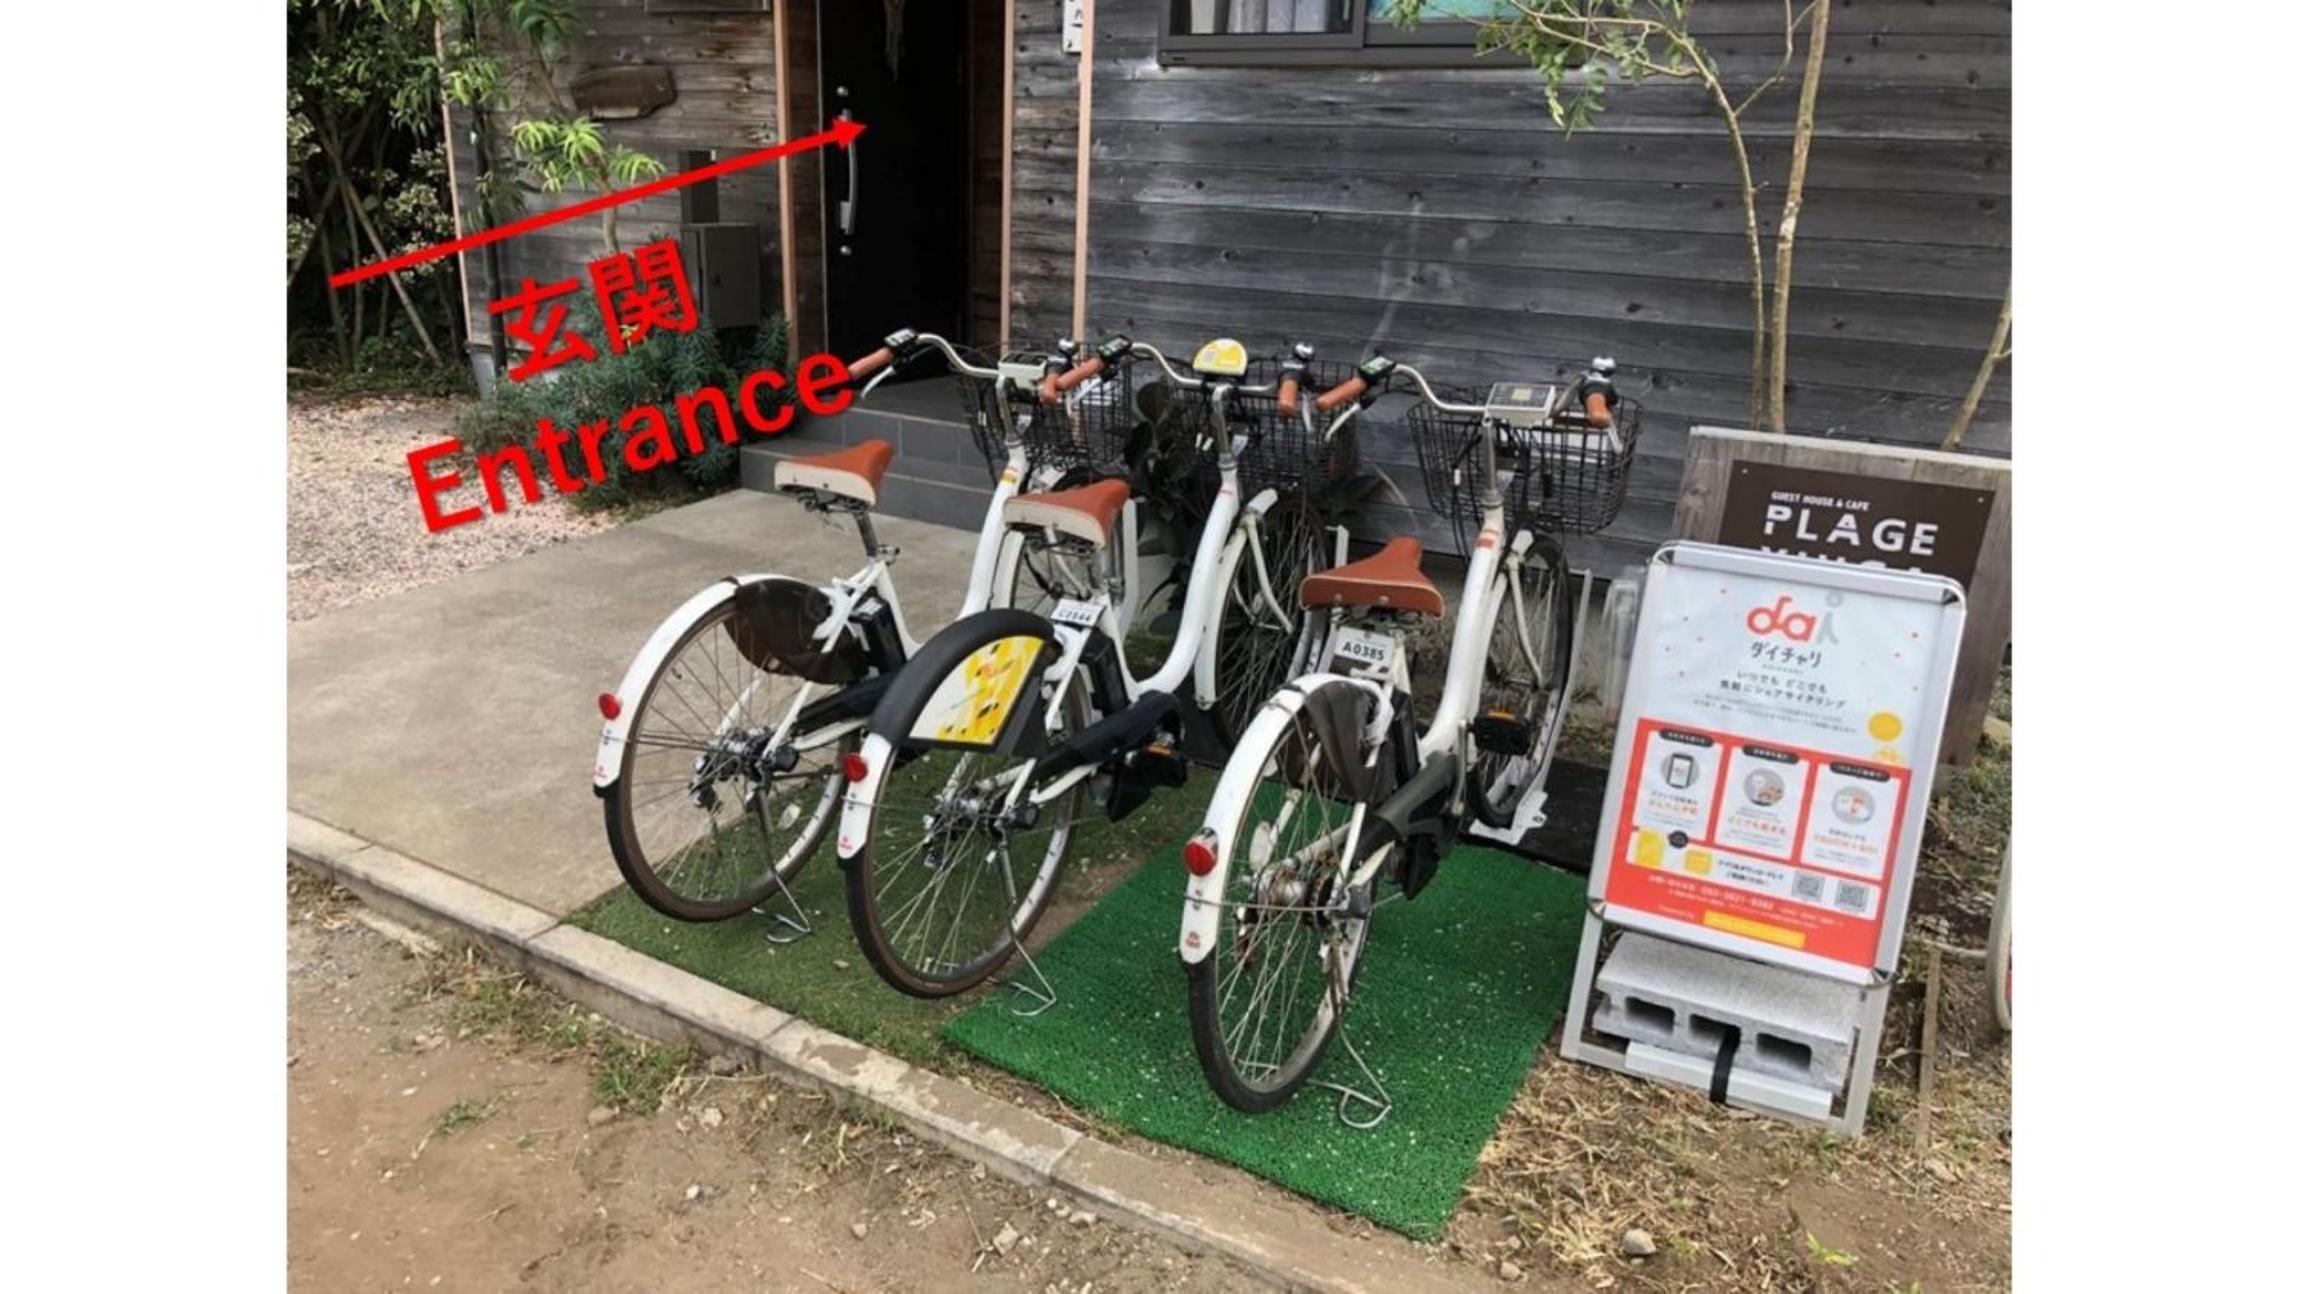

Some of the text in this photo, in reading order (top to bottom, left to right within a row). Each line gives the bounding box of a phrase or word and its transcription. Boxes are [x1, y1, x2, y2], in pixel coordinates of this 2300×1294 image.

[1771, 490, 1870, 512] GUEST HOUSE & CAFE
[1763, 504, 1938, 556] PLAGE
[1342, 641, 1385, 661] A0385
[1751, 641, 1822, 668] ダイチャリ
